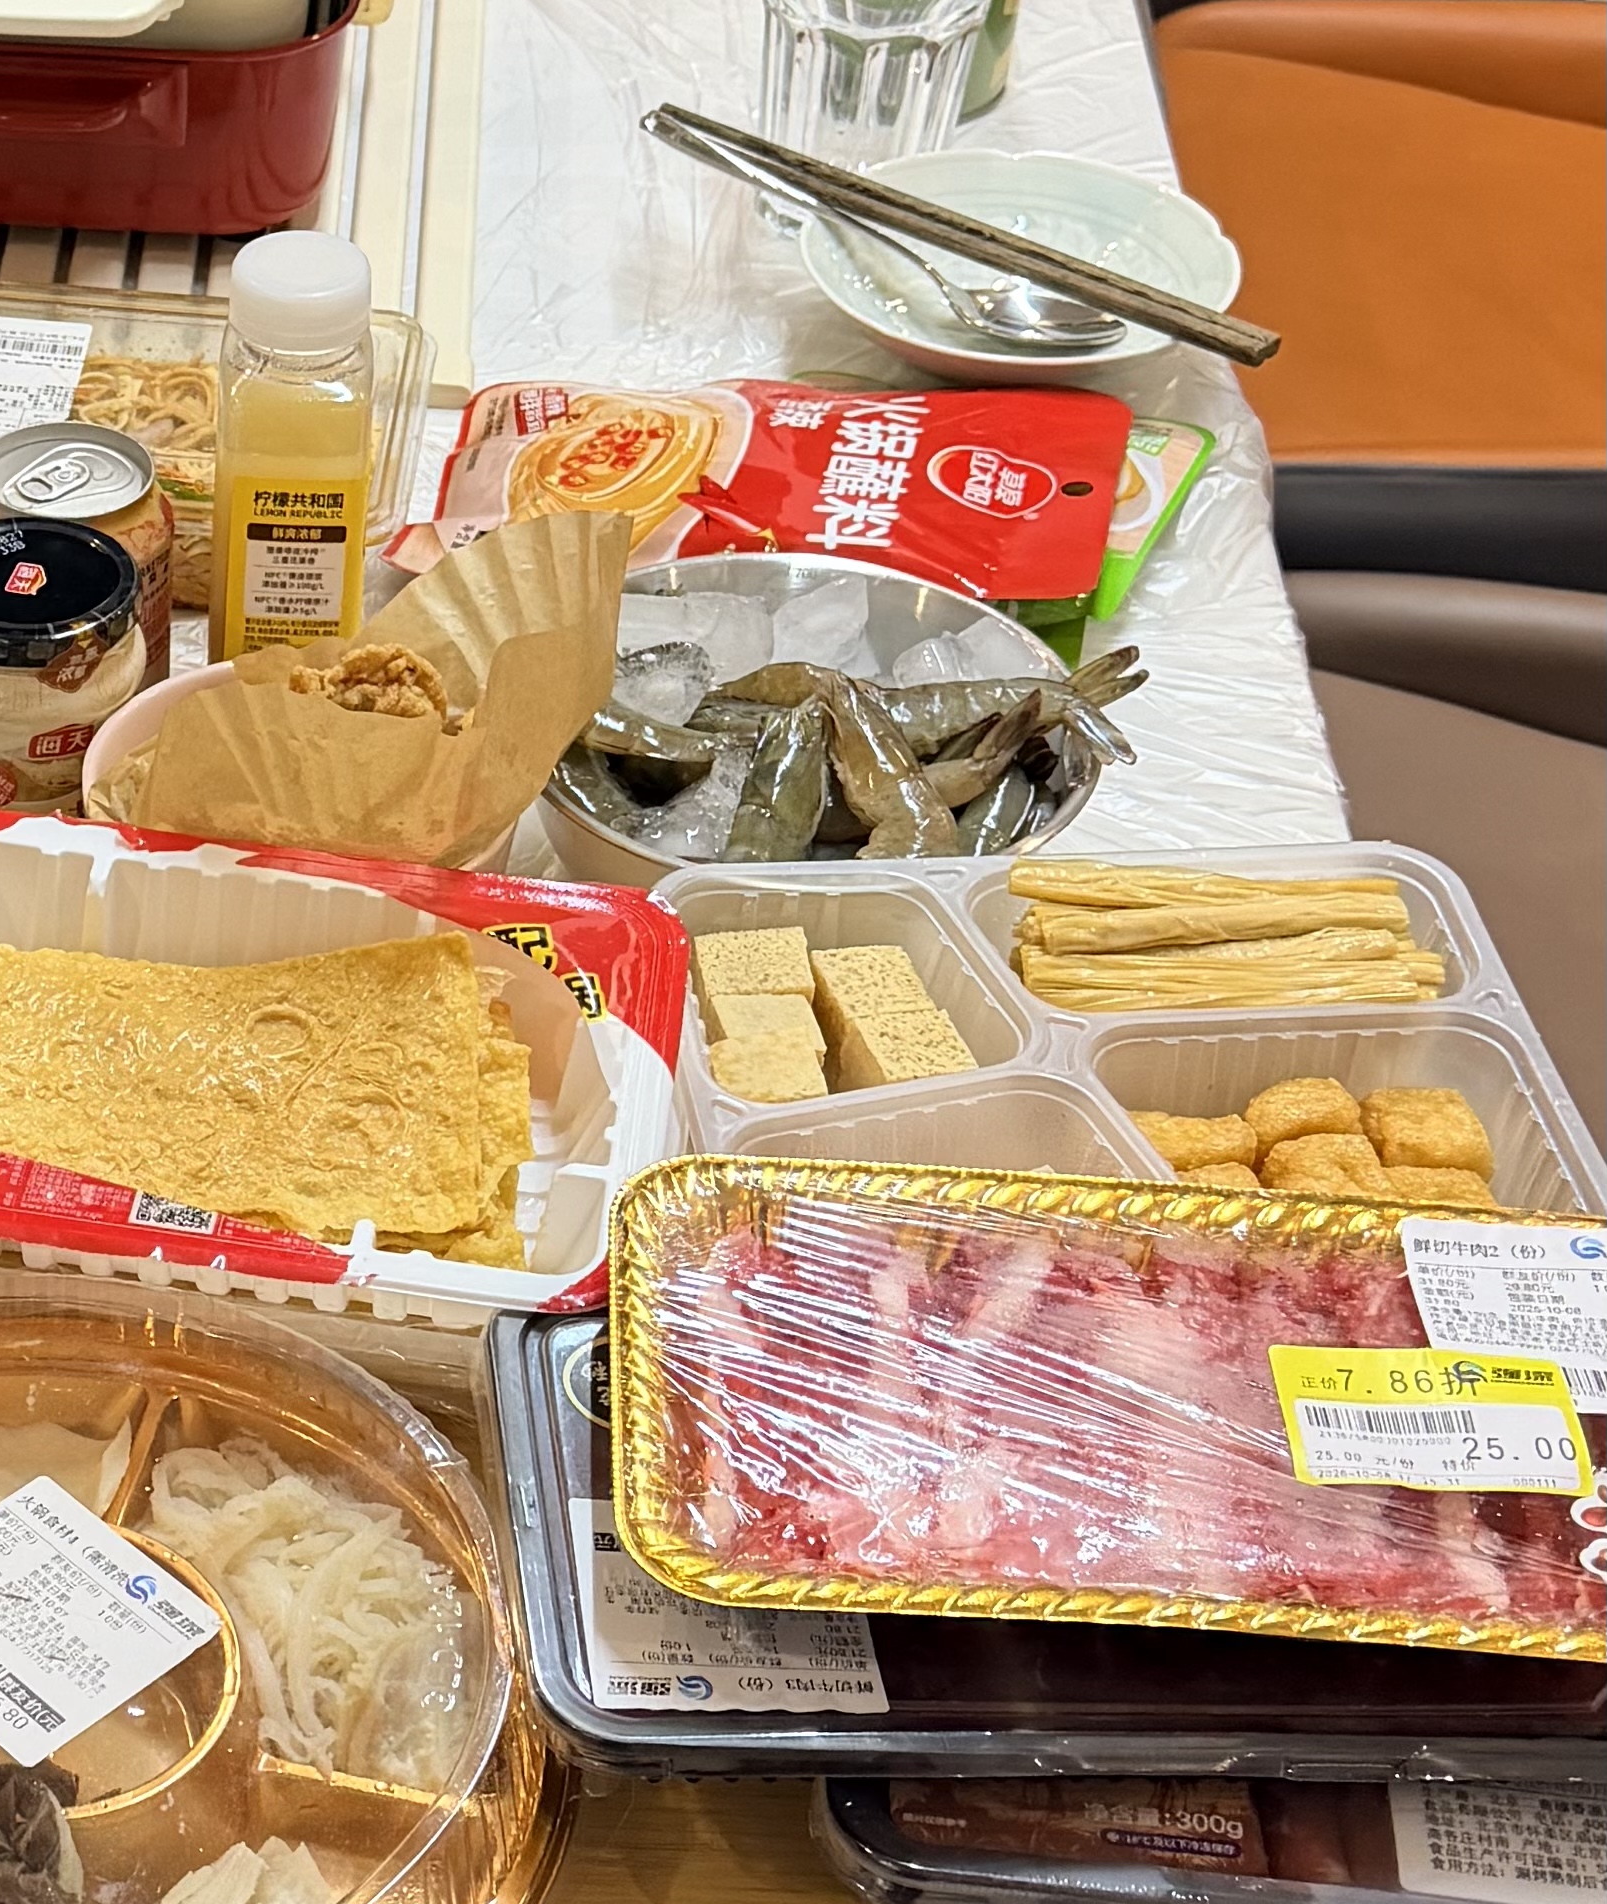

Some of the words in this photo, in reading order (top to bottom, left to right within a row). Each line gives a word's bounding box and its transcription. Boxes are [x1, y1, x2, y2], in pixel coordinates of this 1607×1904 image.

[804, 394, 932, 550] 火锅蘸料
[254, 510, 286, 518] LEMON
[290, 510, 343, 519] REPUBLIC
[1462, 1437, 1577, 1461] 25.00
